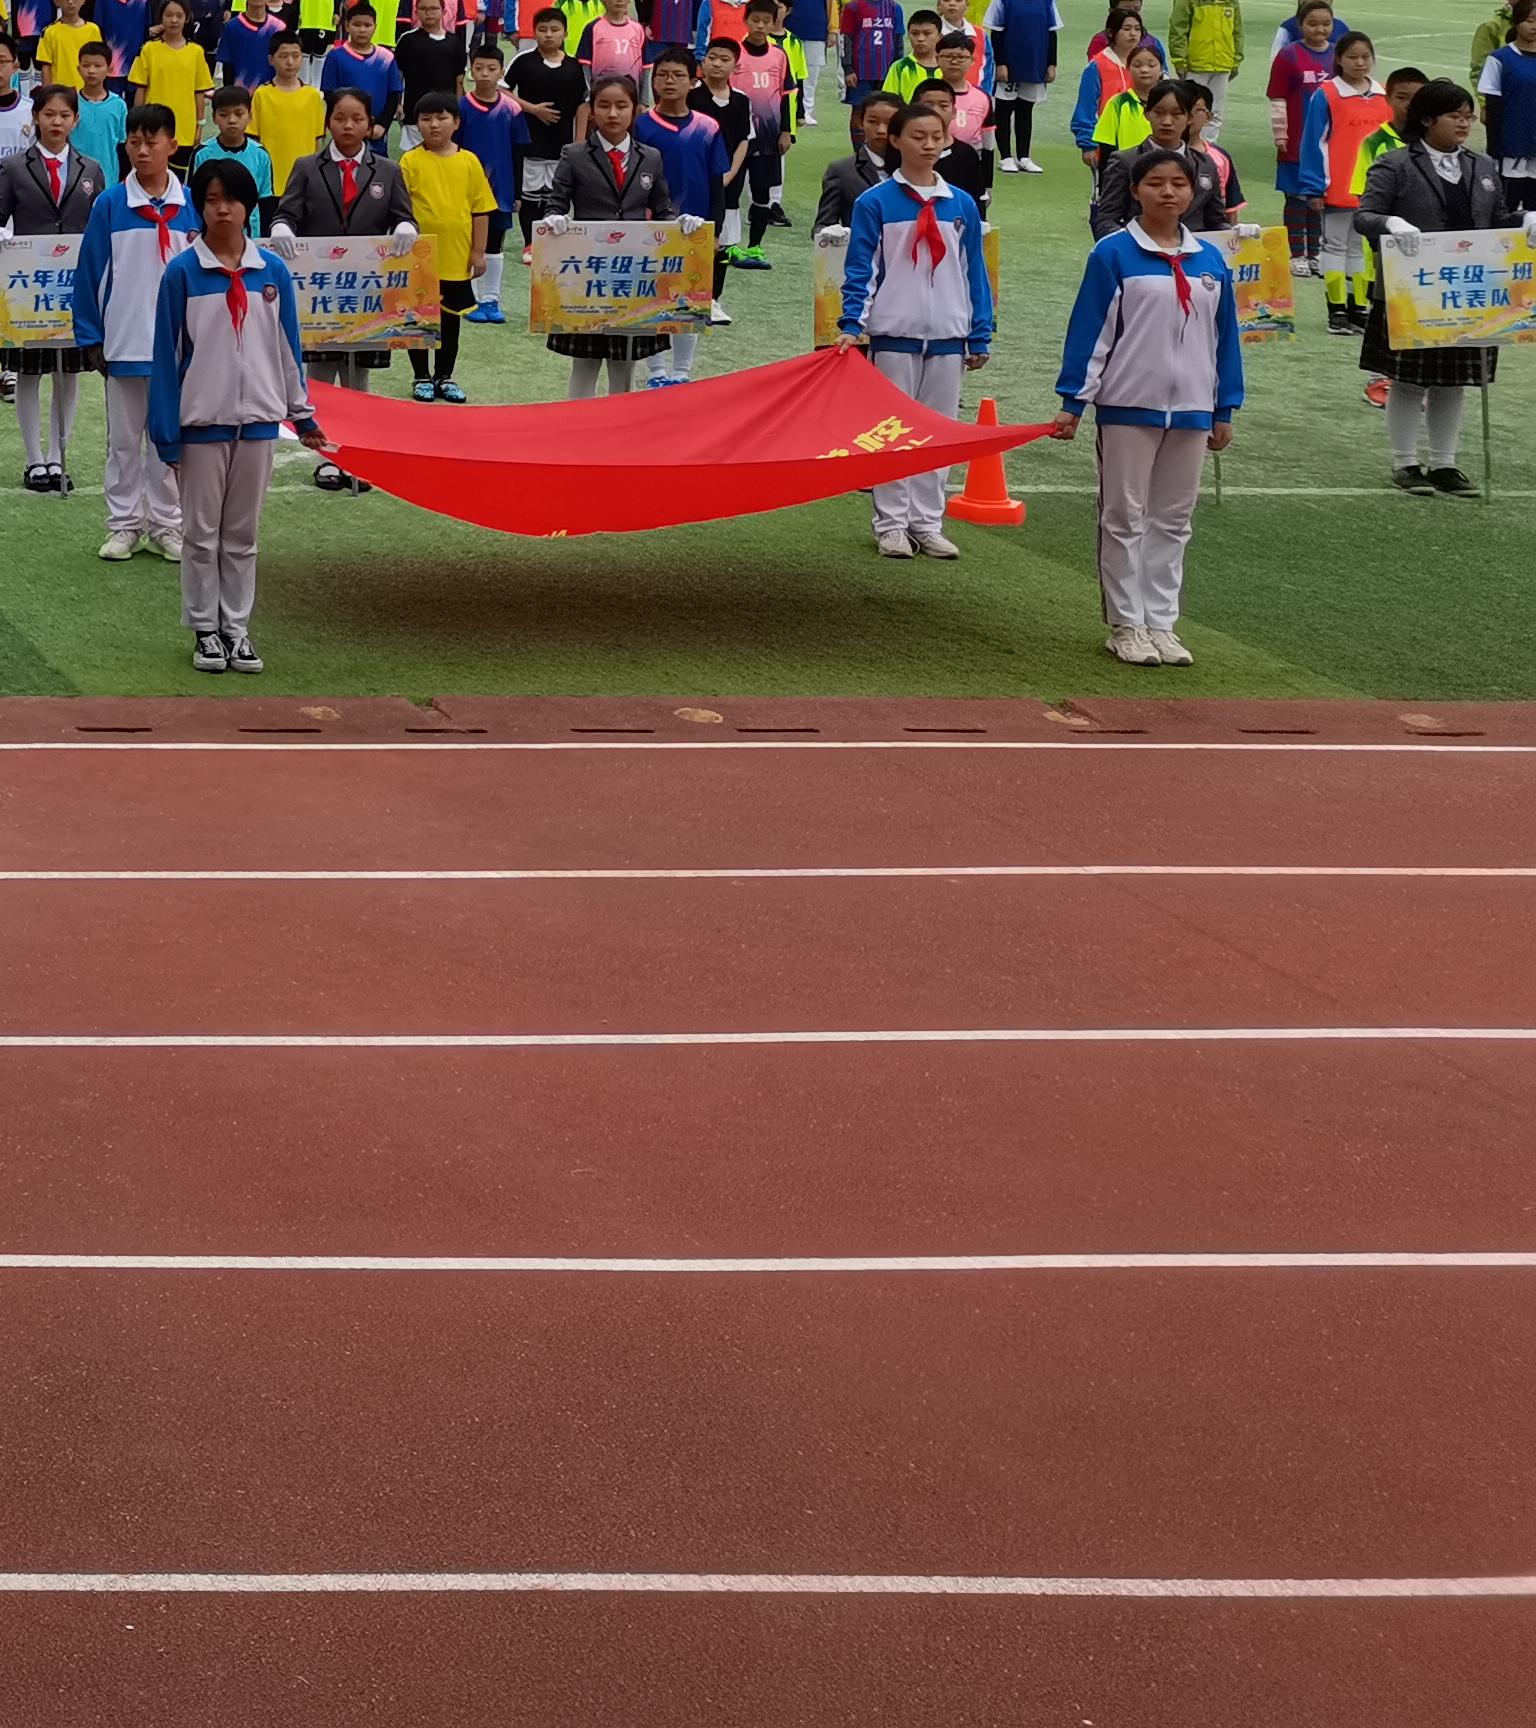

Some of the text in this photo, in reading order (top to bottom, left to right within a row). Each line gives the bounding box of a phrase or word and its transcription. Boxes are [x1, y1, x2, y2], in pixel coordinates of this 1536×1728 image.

[614, 39, 630, 54] 17
[873, 30, 883, 45] 2
[751, 72, 768, 88] 10
[559, 256, 684, 274] 六年级七班
[1412, 262, 1534, 286] 七年级一班
[585, 279, 658, 298] 代表队
[311, 295, 384, 314] 代表队
[1441, 288, 1512, 310] 代表队
